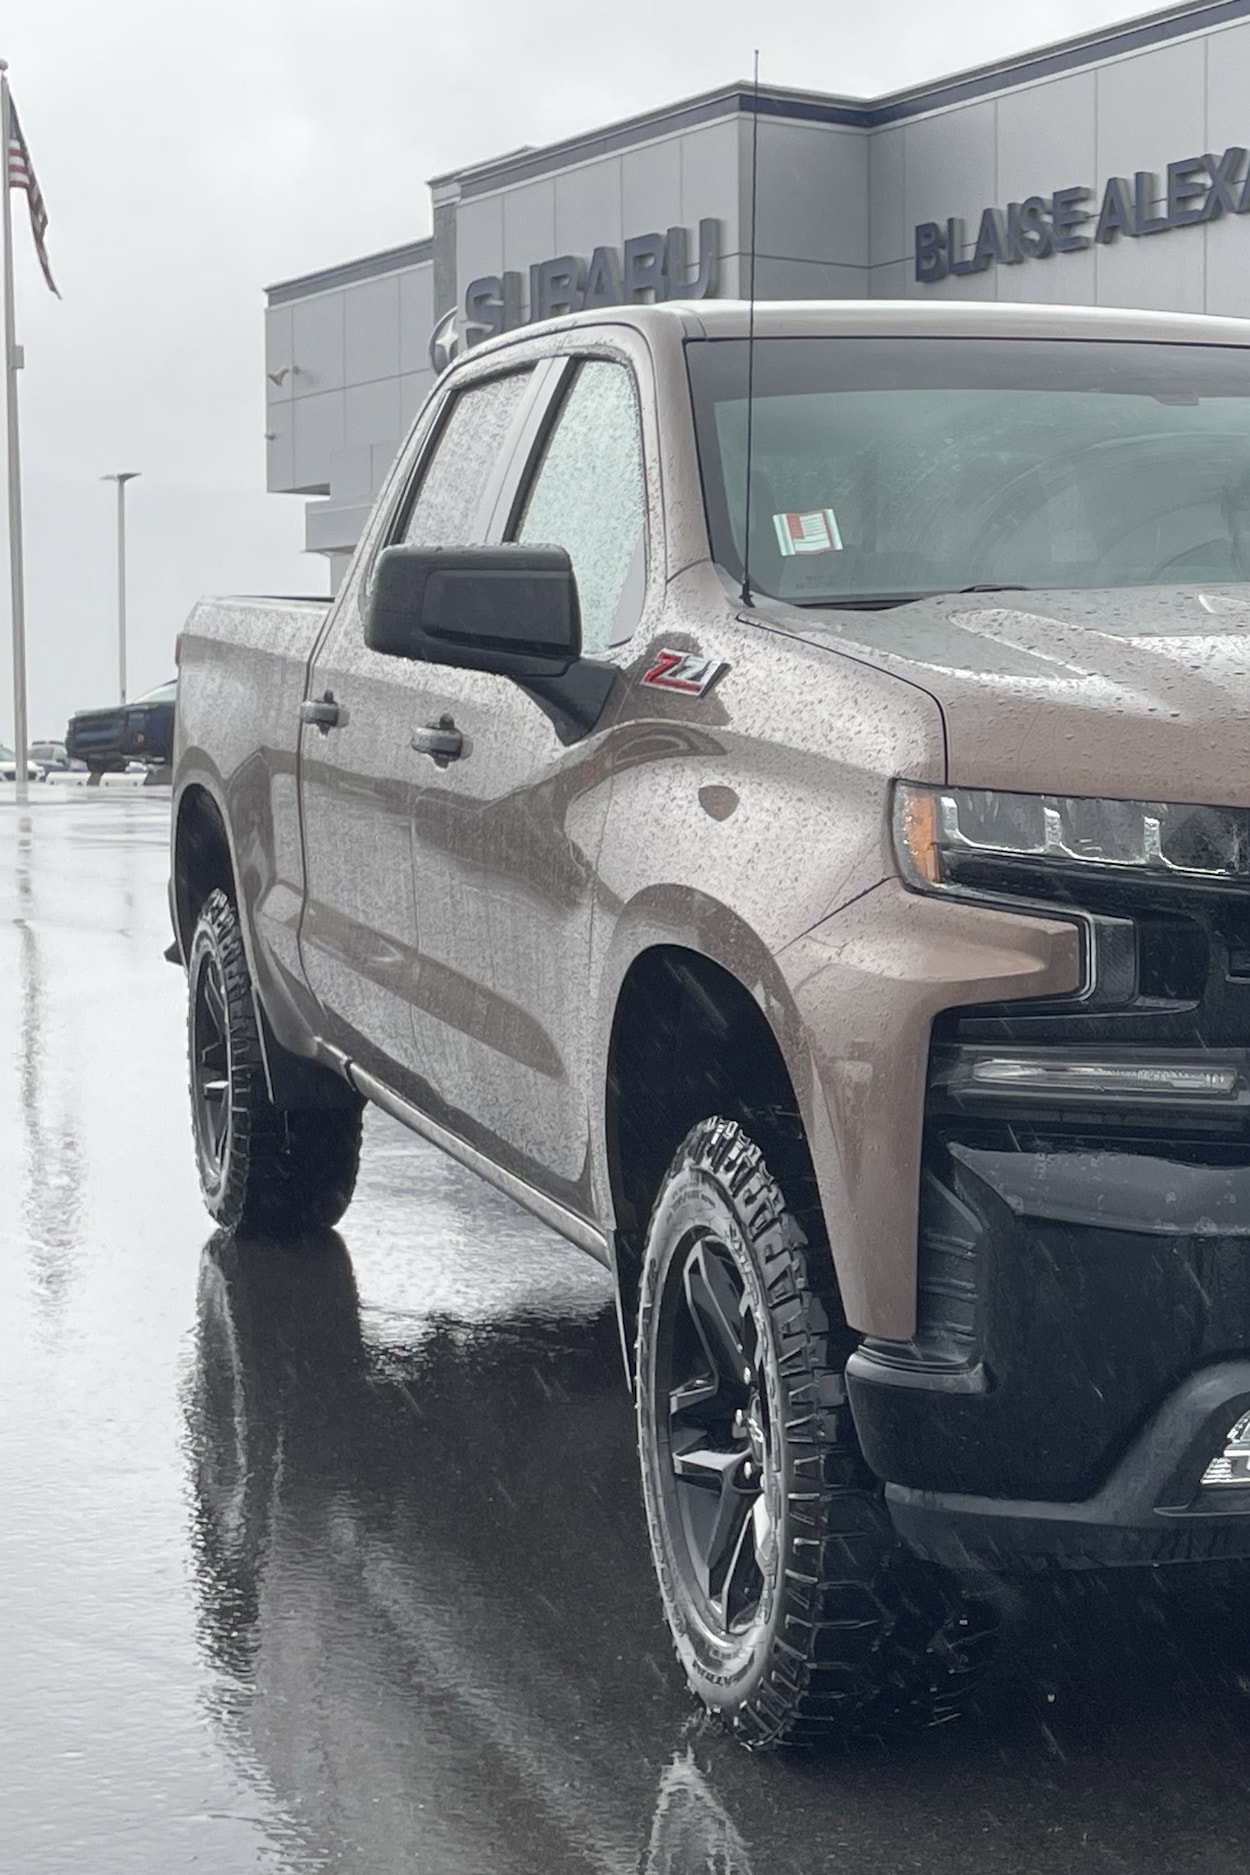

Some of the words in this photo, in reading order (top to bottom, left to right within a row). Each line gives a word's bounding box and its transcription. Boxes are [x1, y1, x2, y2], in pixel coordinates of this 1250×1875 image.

[915, 186, 1089, 282] BLAISE
[466, 218, 720, 348] SUBARU
[641, 648, 731, 698] Z71
